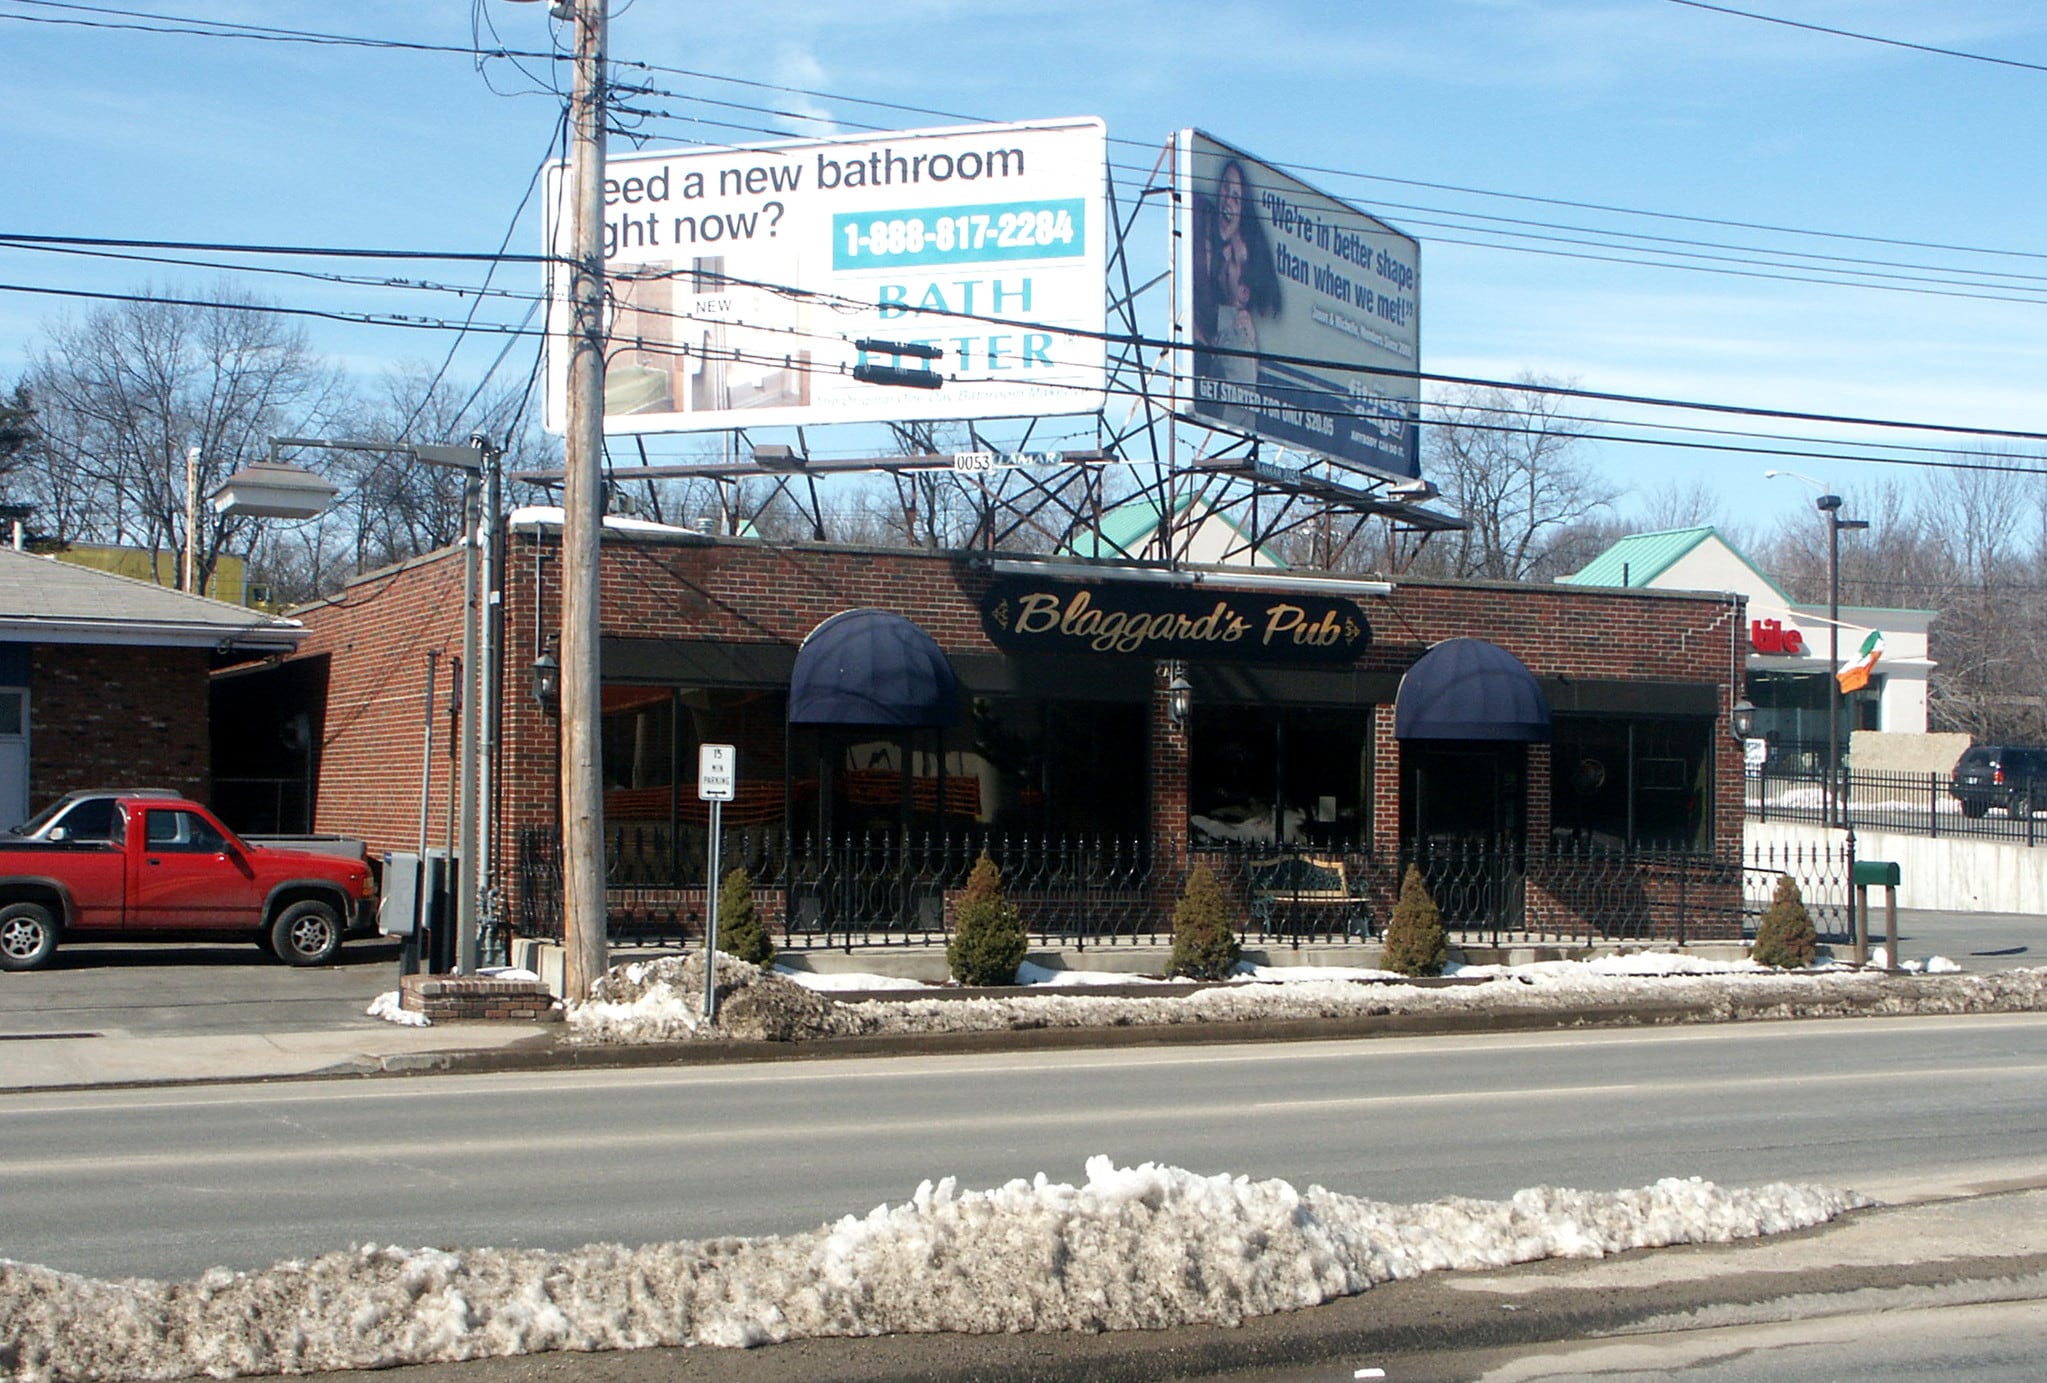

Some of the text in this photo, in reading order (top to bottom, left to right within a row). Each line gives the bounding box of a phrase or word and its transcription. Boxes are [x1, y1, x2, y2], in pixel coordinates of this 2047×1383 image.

[604, 148, 1025, 206] eed a new bathroom
[604, 201, 785, 260] ght now?
[844, 210, 1074, 256] 1-888-817-2284
[1317, 216, 1329, 250] in
[1334, 224, 1373, 270] better
[1376, 249, 1413, 291] shape
[879, 277, 1032, 320] BATH
[1277, 242, 1309, 286] than
[1313, 263, 1351, 303] when
[1355, 283, 1374, 313] we
[696, 300, 732, 314] NEW
[1200, 379, 1219, 400] GET
[1220, 382, 1261, 413] STARTED
[1262, 395, 1281, 420] FOR
[1282, 402, 1304, 427] ONLY
[957, 454, 990, 470] 0053
[1000, 452, 1056, 465] LAMAR
[1015, 590, 1341, 652] Blaggard's Pub
[714, 748, 723, 759] 15
[704, 776, 730, 786] PARKING
